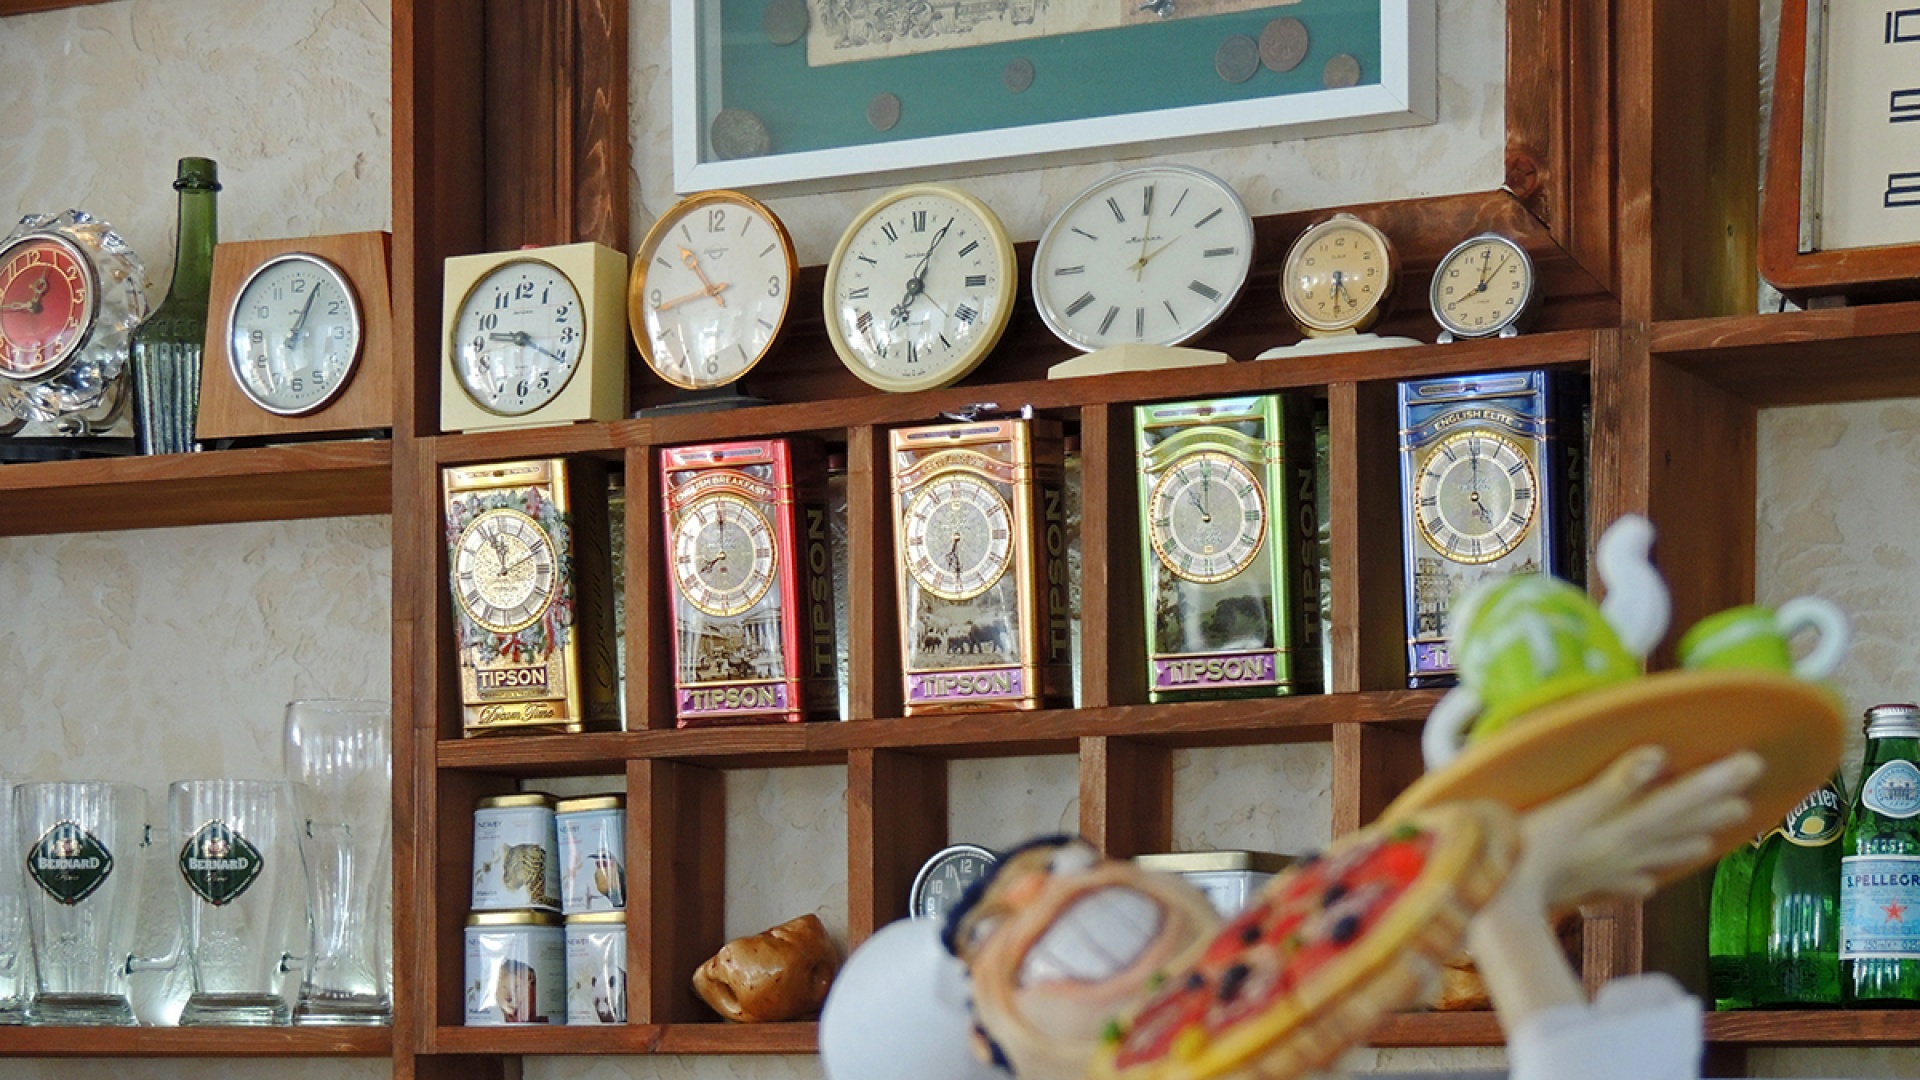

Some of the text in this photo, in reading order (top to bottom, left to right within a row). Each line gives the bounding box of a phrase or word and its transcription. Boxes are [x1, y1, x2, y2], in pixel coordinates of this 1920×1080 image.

[708, 209, 726, 233] 12
[27, 250, 41, 266] 12
[53, 250, 59, 266] 1
[66, 265, 78, 281] 2
[273, 287, 283, 301] 11
[291, 279, 306, 294] 12
[515, 281, 534, 300] 12
[768, 275, 780, 298] 3
[73, 290, 86, 304] 3
[495, 291, 510, 310] 11
[541, 287, 549, 305] 1
[650, 289, 662, 309] 9
[257, 305, 270, 319] 10
[327, 301, 340, 316] 2
[555, 305, 569, 323] 2
[478, 313, 498, 331] 10
[252, 330, 263, 343] 9
[333, 326, 345, 340] 3
[560, 327, 573, 345] 3
[473, 335, 485, 353] 9
[257, 354, 267, 369] 8
[478, 355, 491, 374] 8
[706, 354, 719, 375] 6
[292, 378, 303, 393] 6
[312, 370, 324, 385] 5
[537, 371, 550, 390] 5
[516, 380, 529, 398] 6
[1434, 410, 1513, 431] ENGLISH ELITE
[712, 475, 767, 495] BREAKFAST
[1297, 469, 1321, 644] TIPSON
[1044, 488, 1067, 660] TIPSON
[807, 508, 834, 678] TIPSON
[477, 669, 545, 687] TIPSON
[1165, 656, 1266, 684] TIPSON
[919, 673, 1012, 699] TIPSON
[691, 686, 777, 711] TIPSON
[478, 704, 521, 724] Dream
[37, 857, 101, 870] BERNARD
[188, 857, 249, 870] BERNARD
[960, 858, 973, 874] 12
[930, 879, 943, 896] 10
